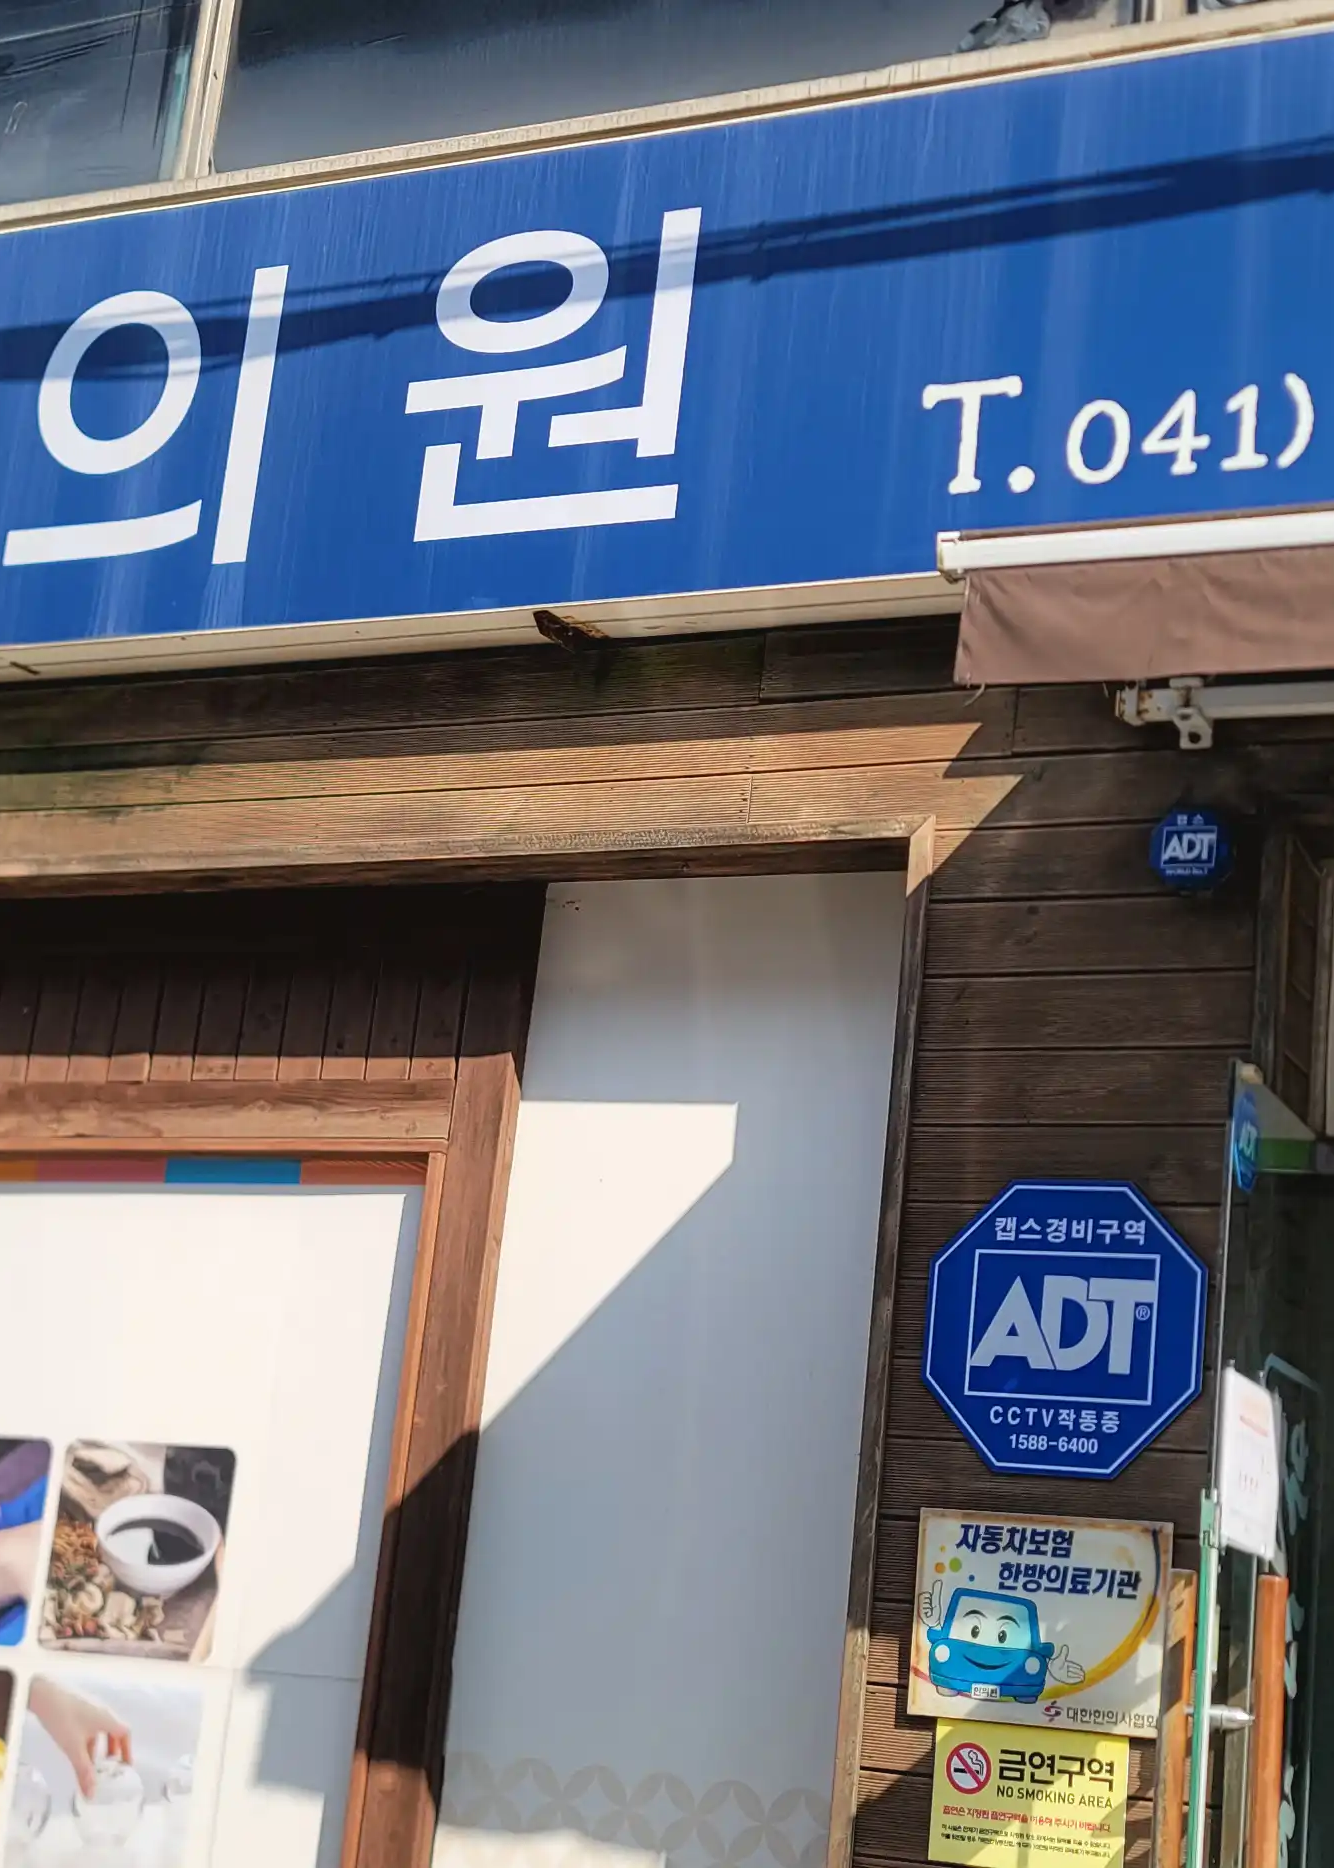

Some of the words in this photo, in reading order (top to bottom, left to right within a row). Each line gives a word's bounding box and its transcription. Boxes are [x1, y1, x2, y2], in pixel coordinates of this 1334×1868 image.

[1163, 833, 1216, 860] ADT
[994, 1216, 1147, 1244] 캡스경비구역
[1008, 1433, 1099, 1454] 1588-6400
[955, 1523, 1075, 1559] 자동차보험
[998, 1561, 1142, 1600] 한방의료기관
[998, 1748, 1115, 1792] 금연구역
[996, 1784, 1014, 1798] NO
[1017, 1787, 1075, 1805] SMOKING
[1078, 1795, 1113, 1809] AREA
